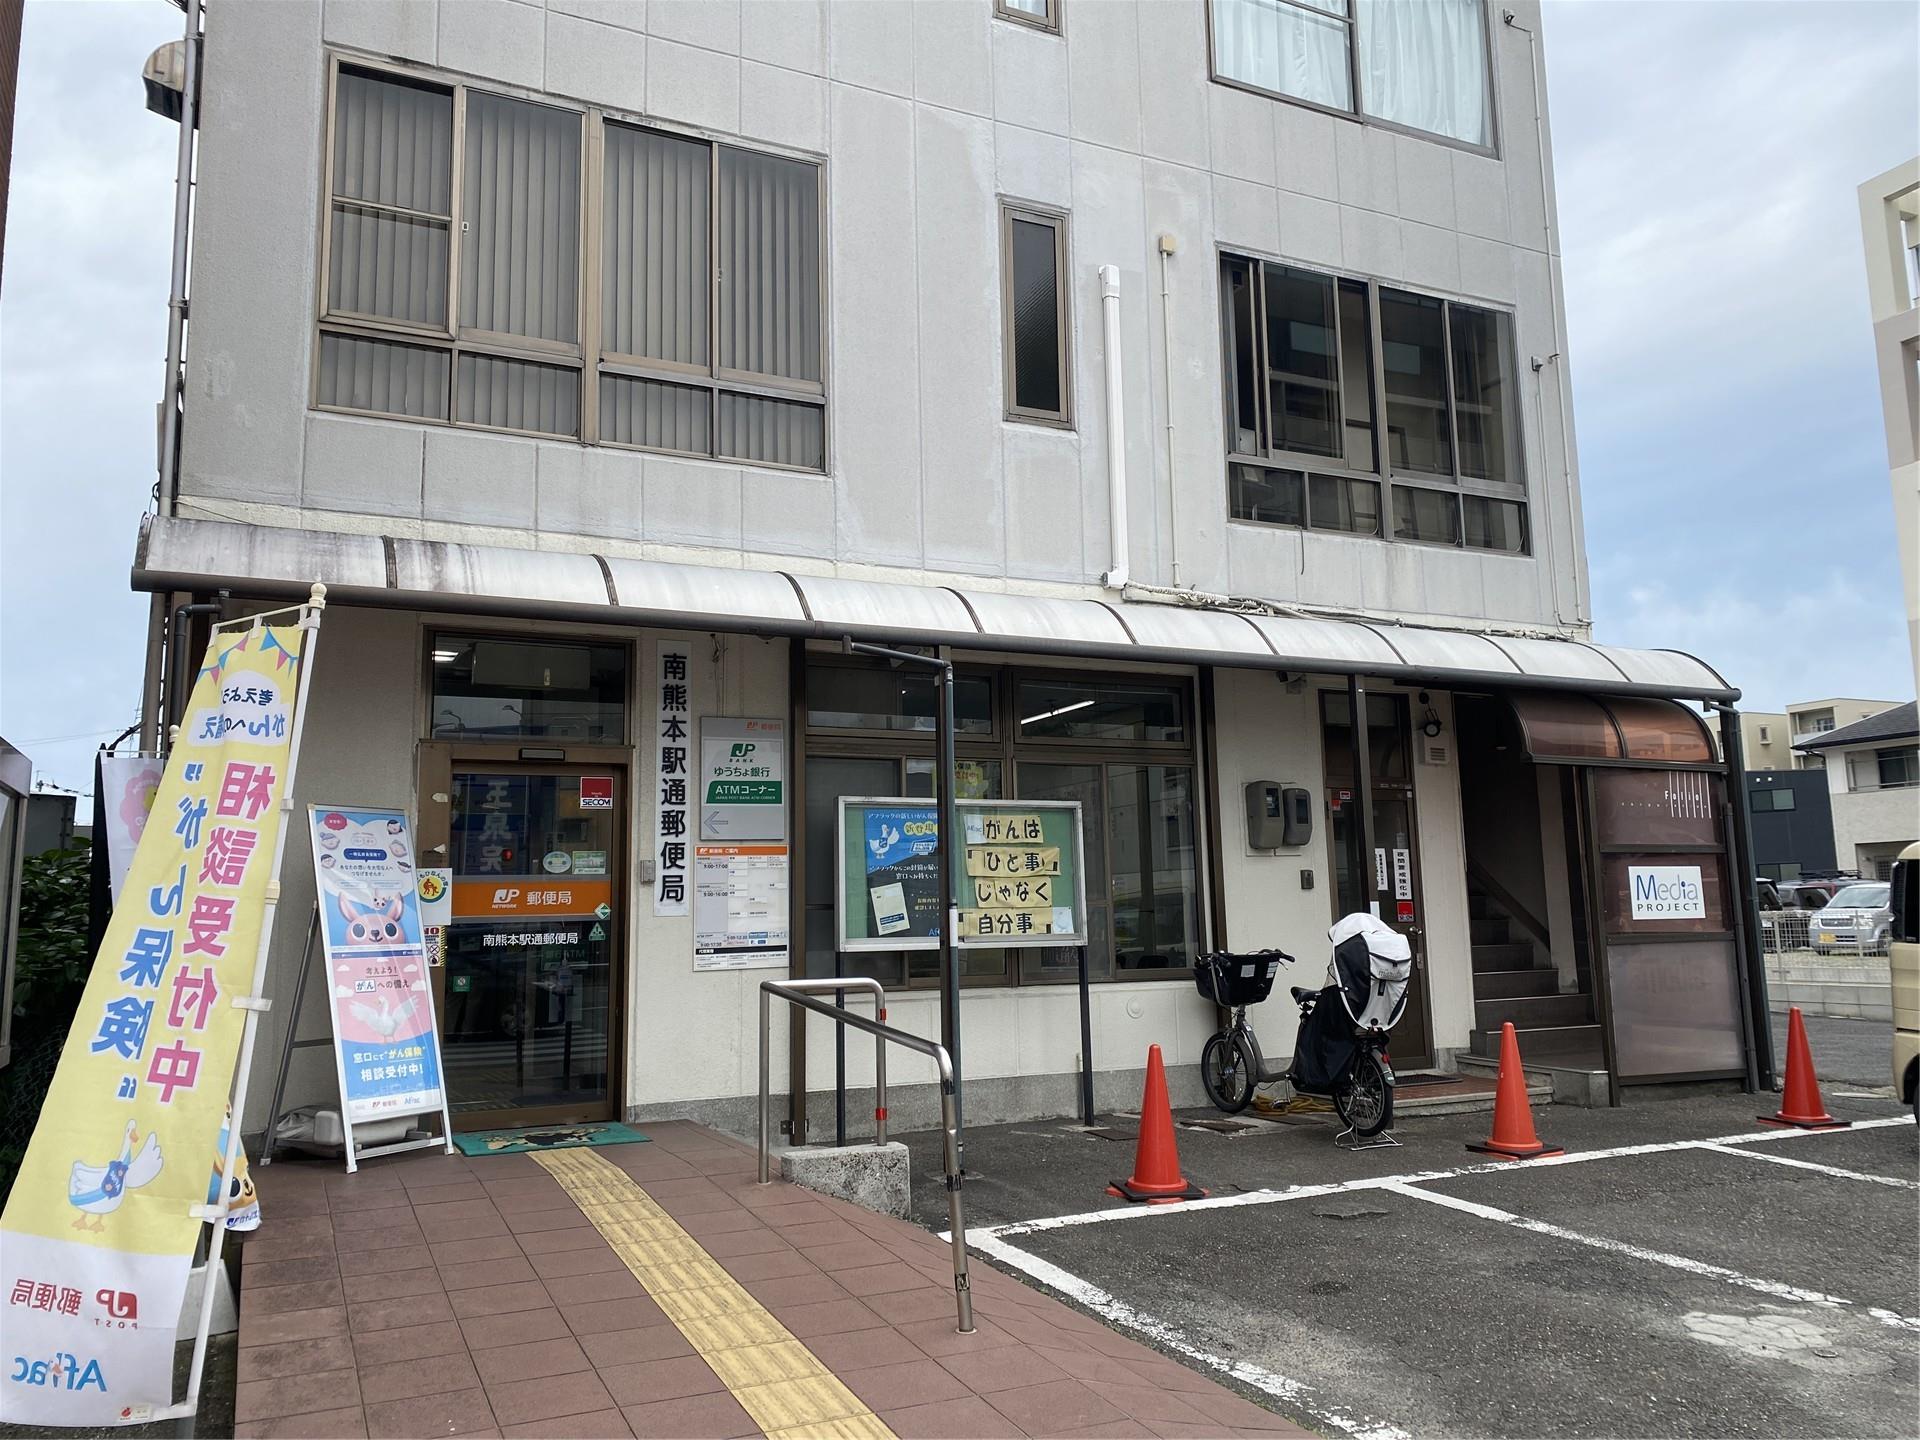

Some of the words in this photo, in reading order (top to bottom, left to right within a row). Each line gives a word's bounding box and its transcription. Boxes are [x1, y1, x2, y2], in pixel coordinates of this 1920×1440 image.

[730, 743, 756, 757] JP
[660, 652, 687, 903] 南熊本駅通郵便局
[714, 766, 771, 777] ゆうちょ銀行
[715, 785, 776, 794] ATMコーナー
[582, 798, 611, 806] SECOM
[986, 819, 1040, 839] がんは
[978, 881, 1049, 902] じゃなく
[1636, 874, 1699, 901] Media
[526, 890, 572, 906] 郵便局
[1637, 902, 1700, 912] PROJECT
[482, 932, 579, 947] 南熊本駅通郵便局
